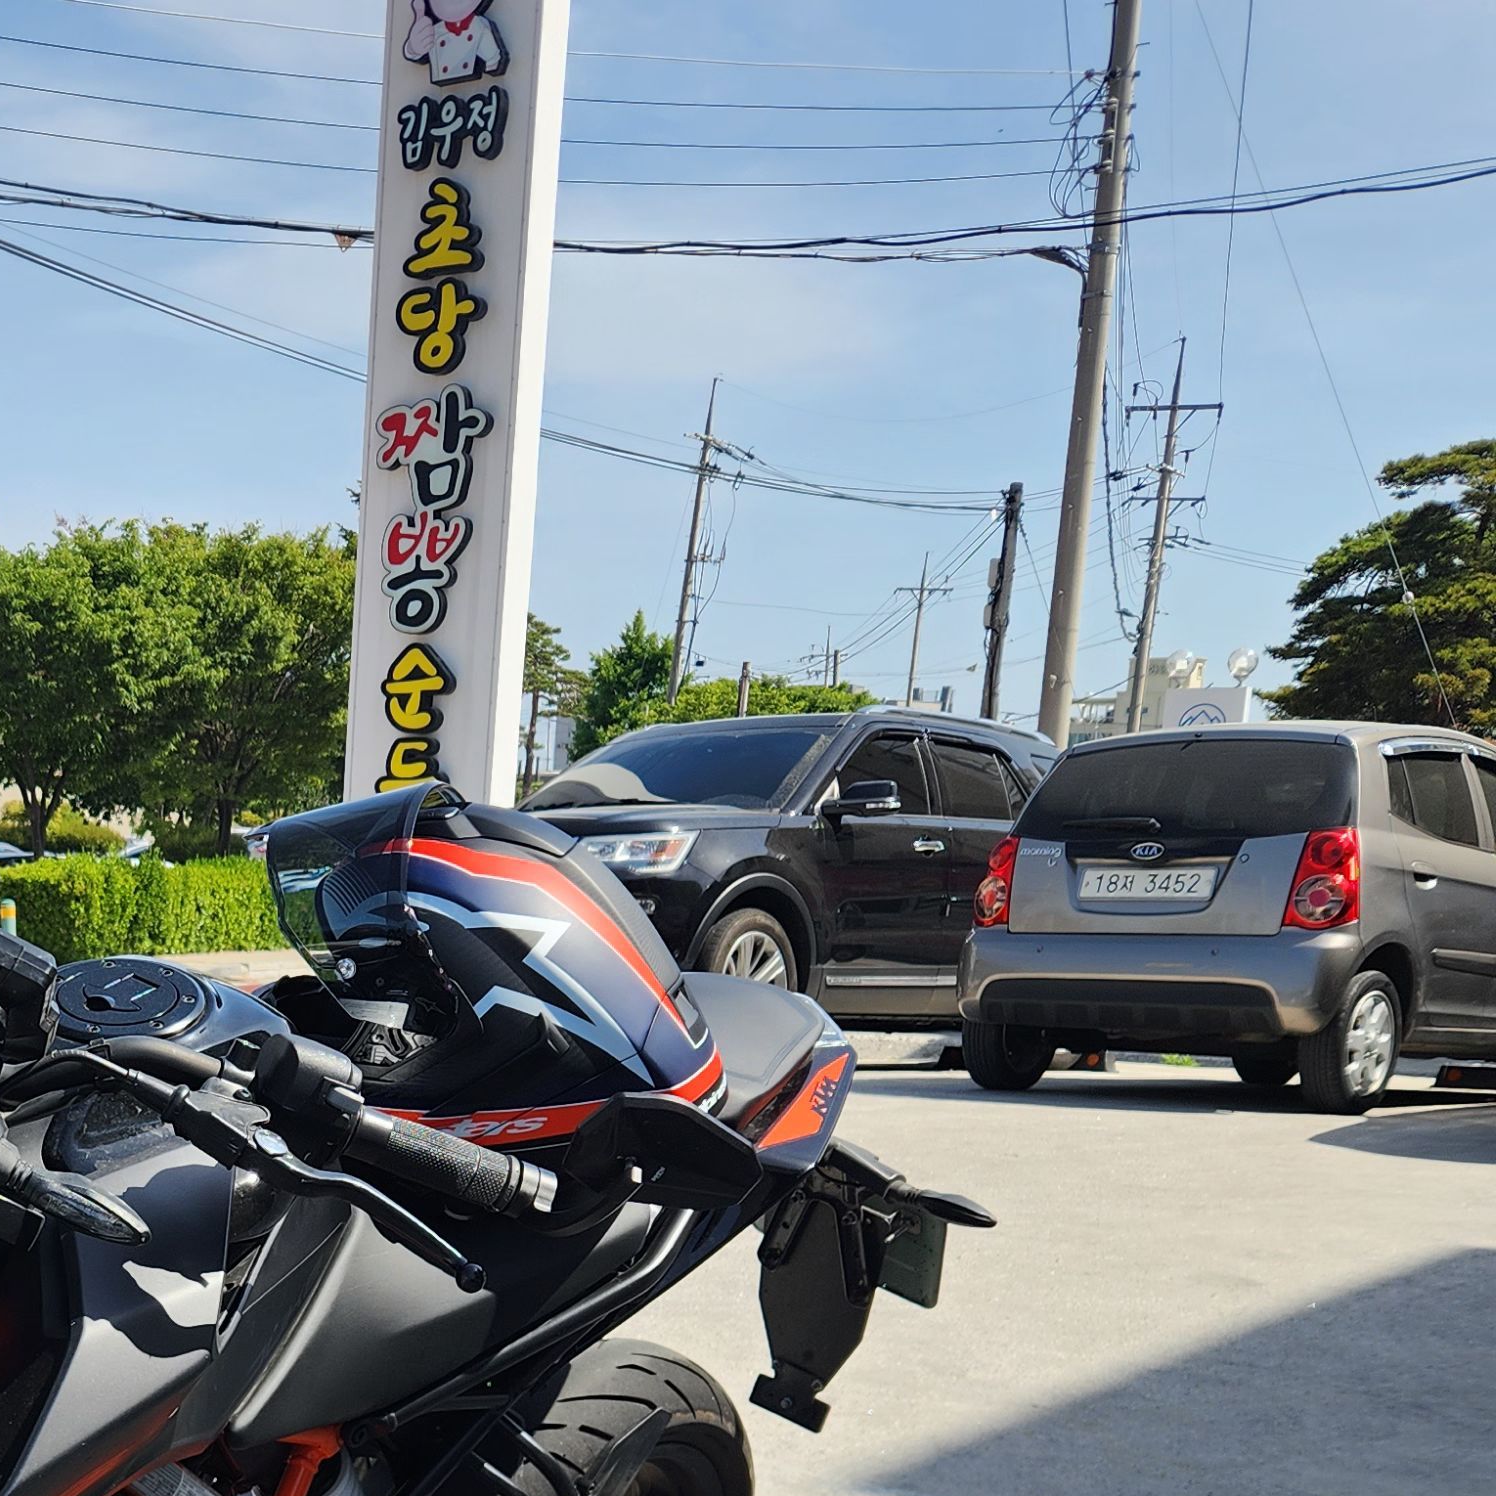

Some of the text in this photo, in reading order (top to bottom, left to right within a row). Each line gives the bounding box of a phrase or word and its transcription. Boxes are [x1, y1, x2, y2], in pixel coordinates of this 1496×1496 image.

[399, 88, 503, 168] 김우정
[399, 180, 479, 371] 초당
[378, 386, 488, 628] 짬뽕
[1020, 846, 1062, 866] morning
[1095, 872, 1202, 894] 18저 3452
